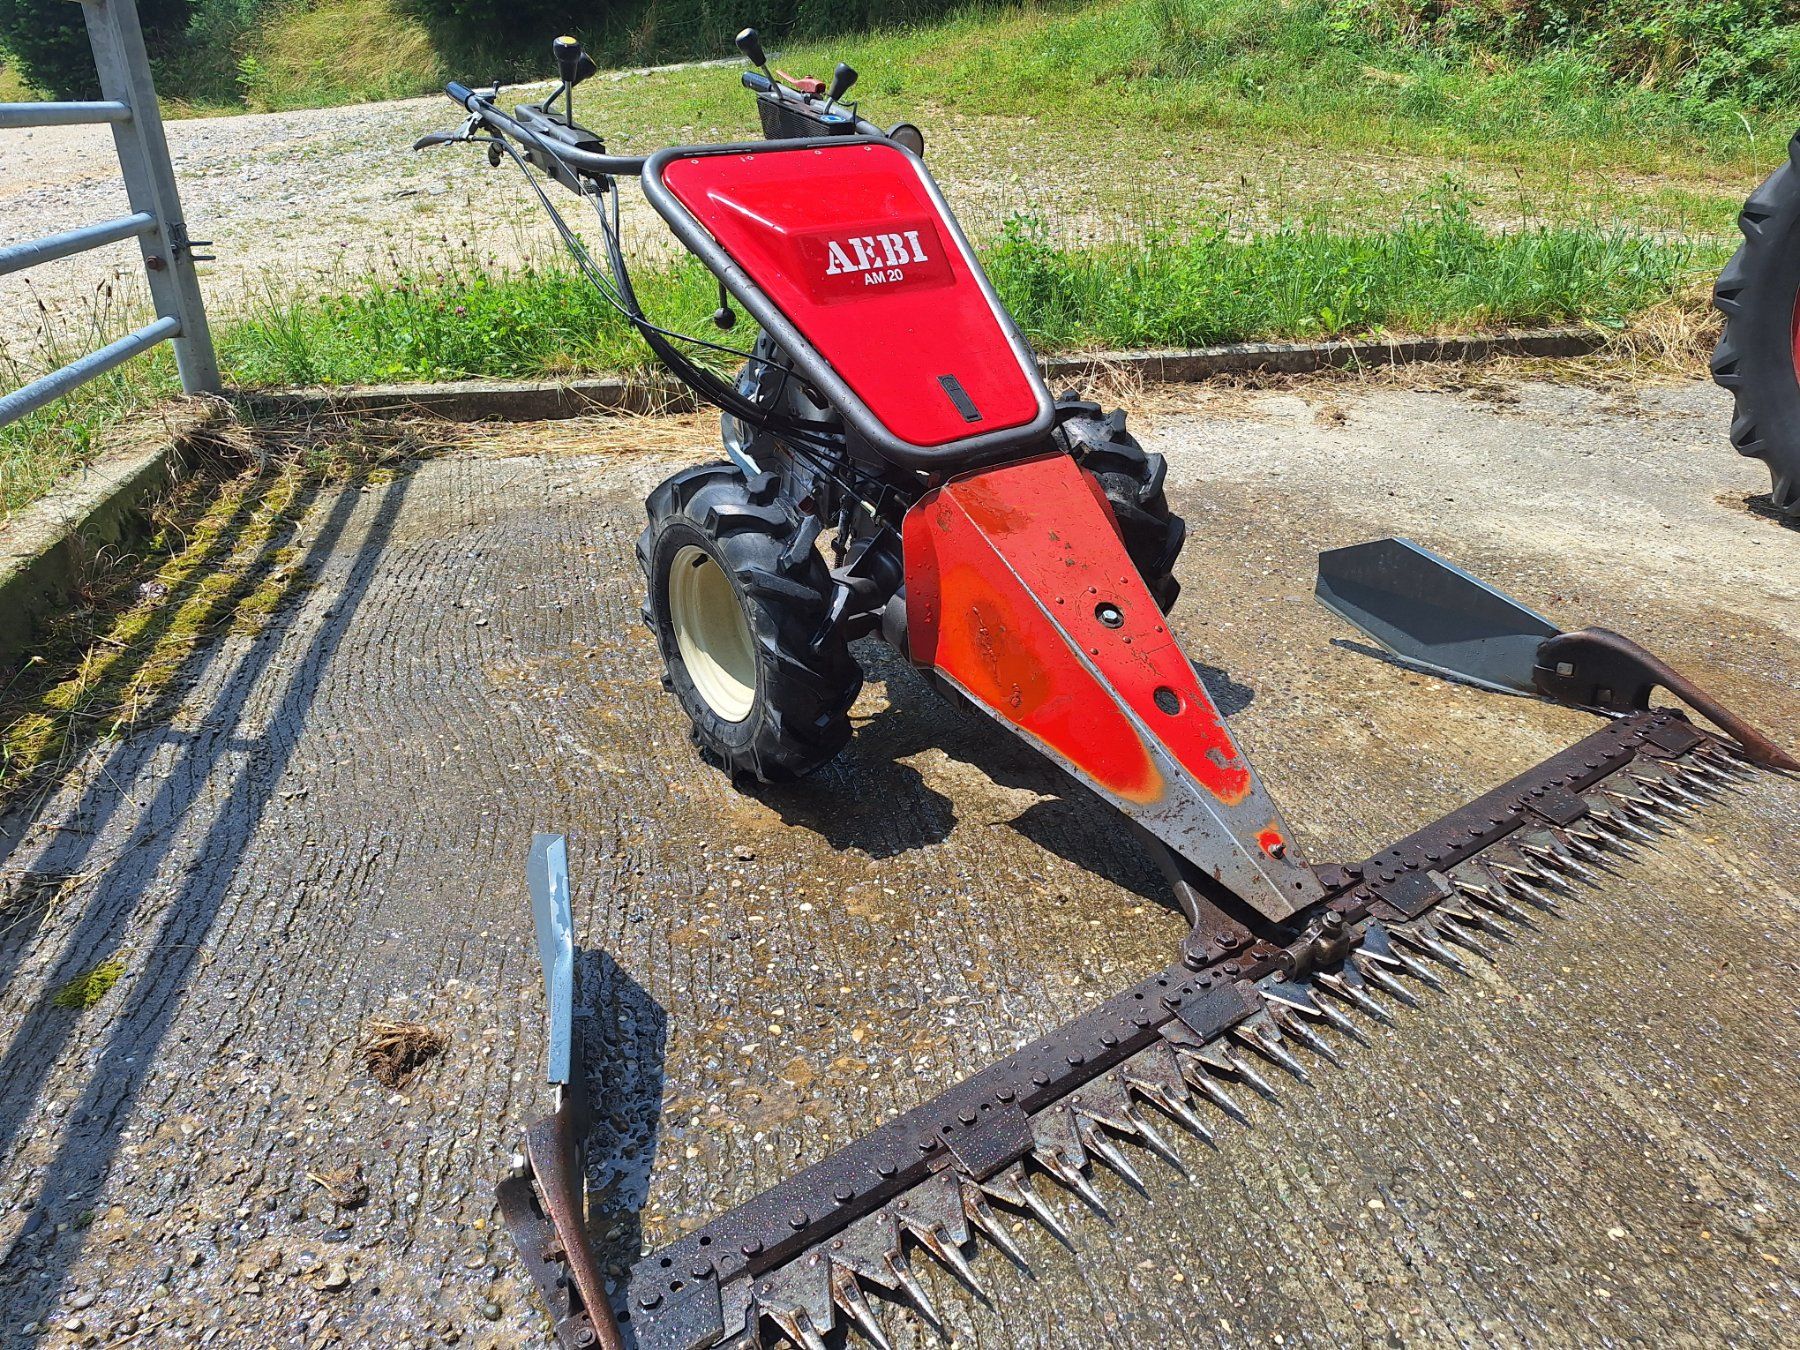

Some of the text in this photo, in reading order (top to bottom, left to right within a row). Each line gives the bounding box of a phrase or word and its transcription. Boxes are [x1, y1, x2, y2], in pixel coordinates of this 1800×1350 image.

[826, 230, 928, 275] AEBI
[864, 268, 904, 286] AM 20
